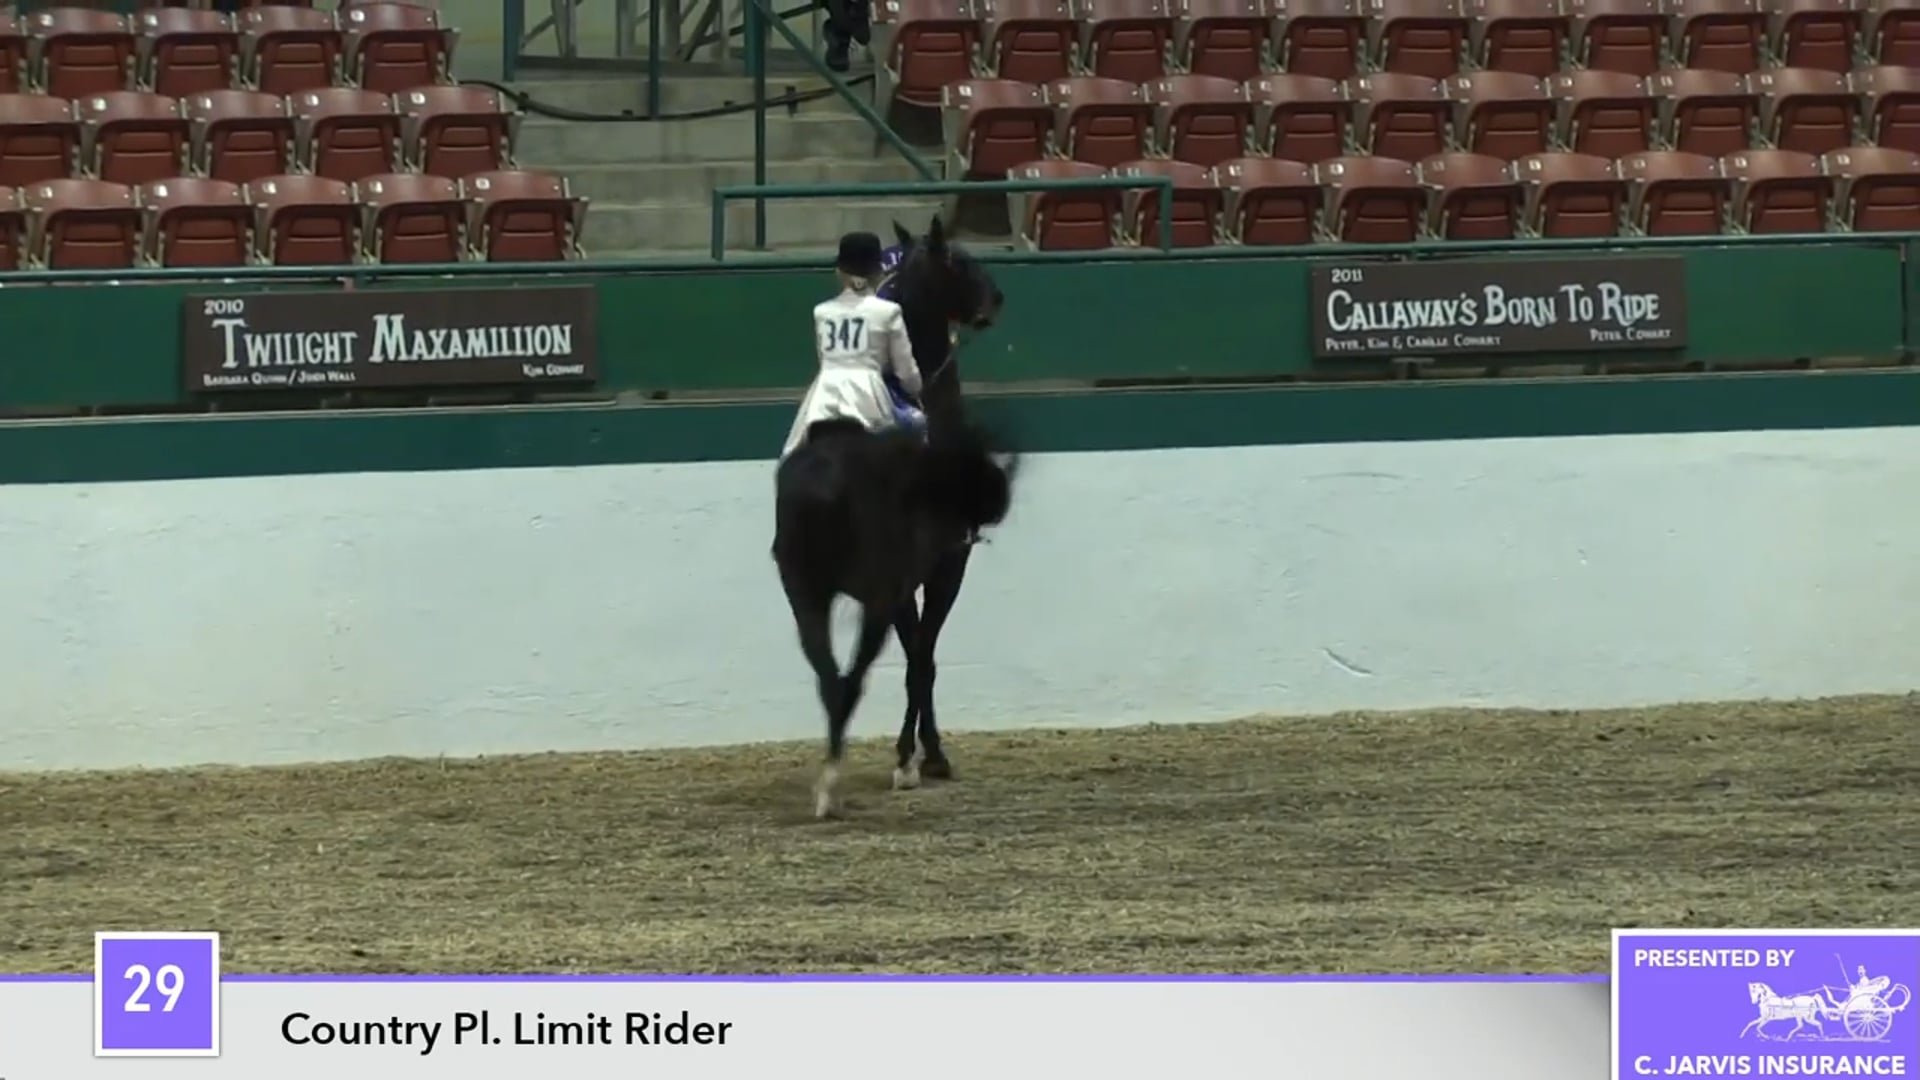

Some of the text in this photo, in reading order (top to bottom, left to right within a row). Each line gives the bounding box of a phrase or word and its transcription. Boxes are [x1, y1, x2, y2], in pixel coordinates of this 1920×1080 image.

[1331, 268, 1363, 283] 2011
[204, 299, 244, 315] 2010
[1327, 283, 1660, 331] CALLAWAY'S BORN TO RIDE
[212, 314, 572, 369] TWILIGHT MAXAMILLION
[825, 318, 864, 352] 347
